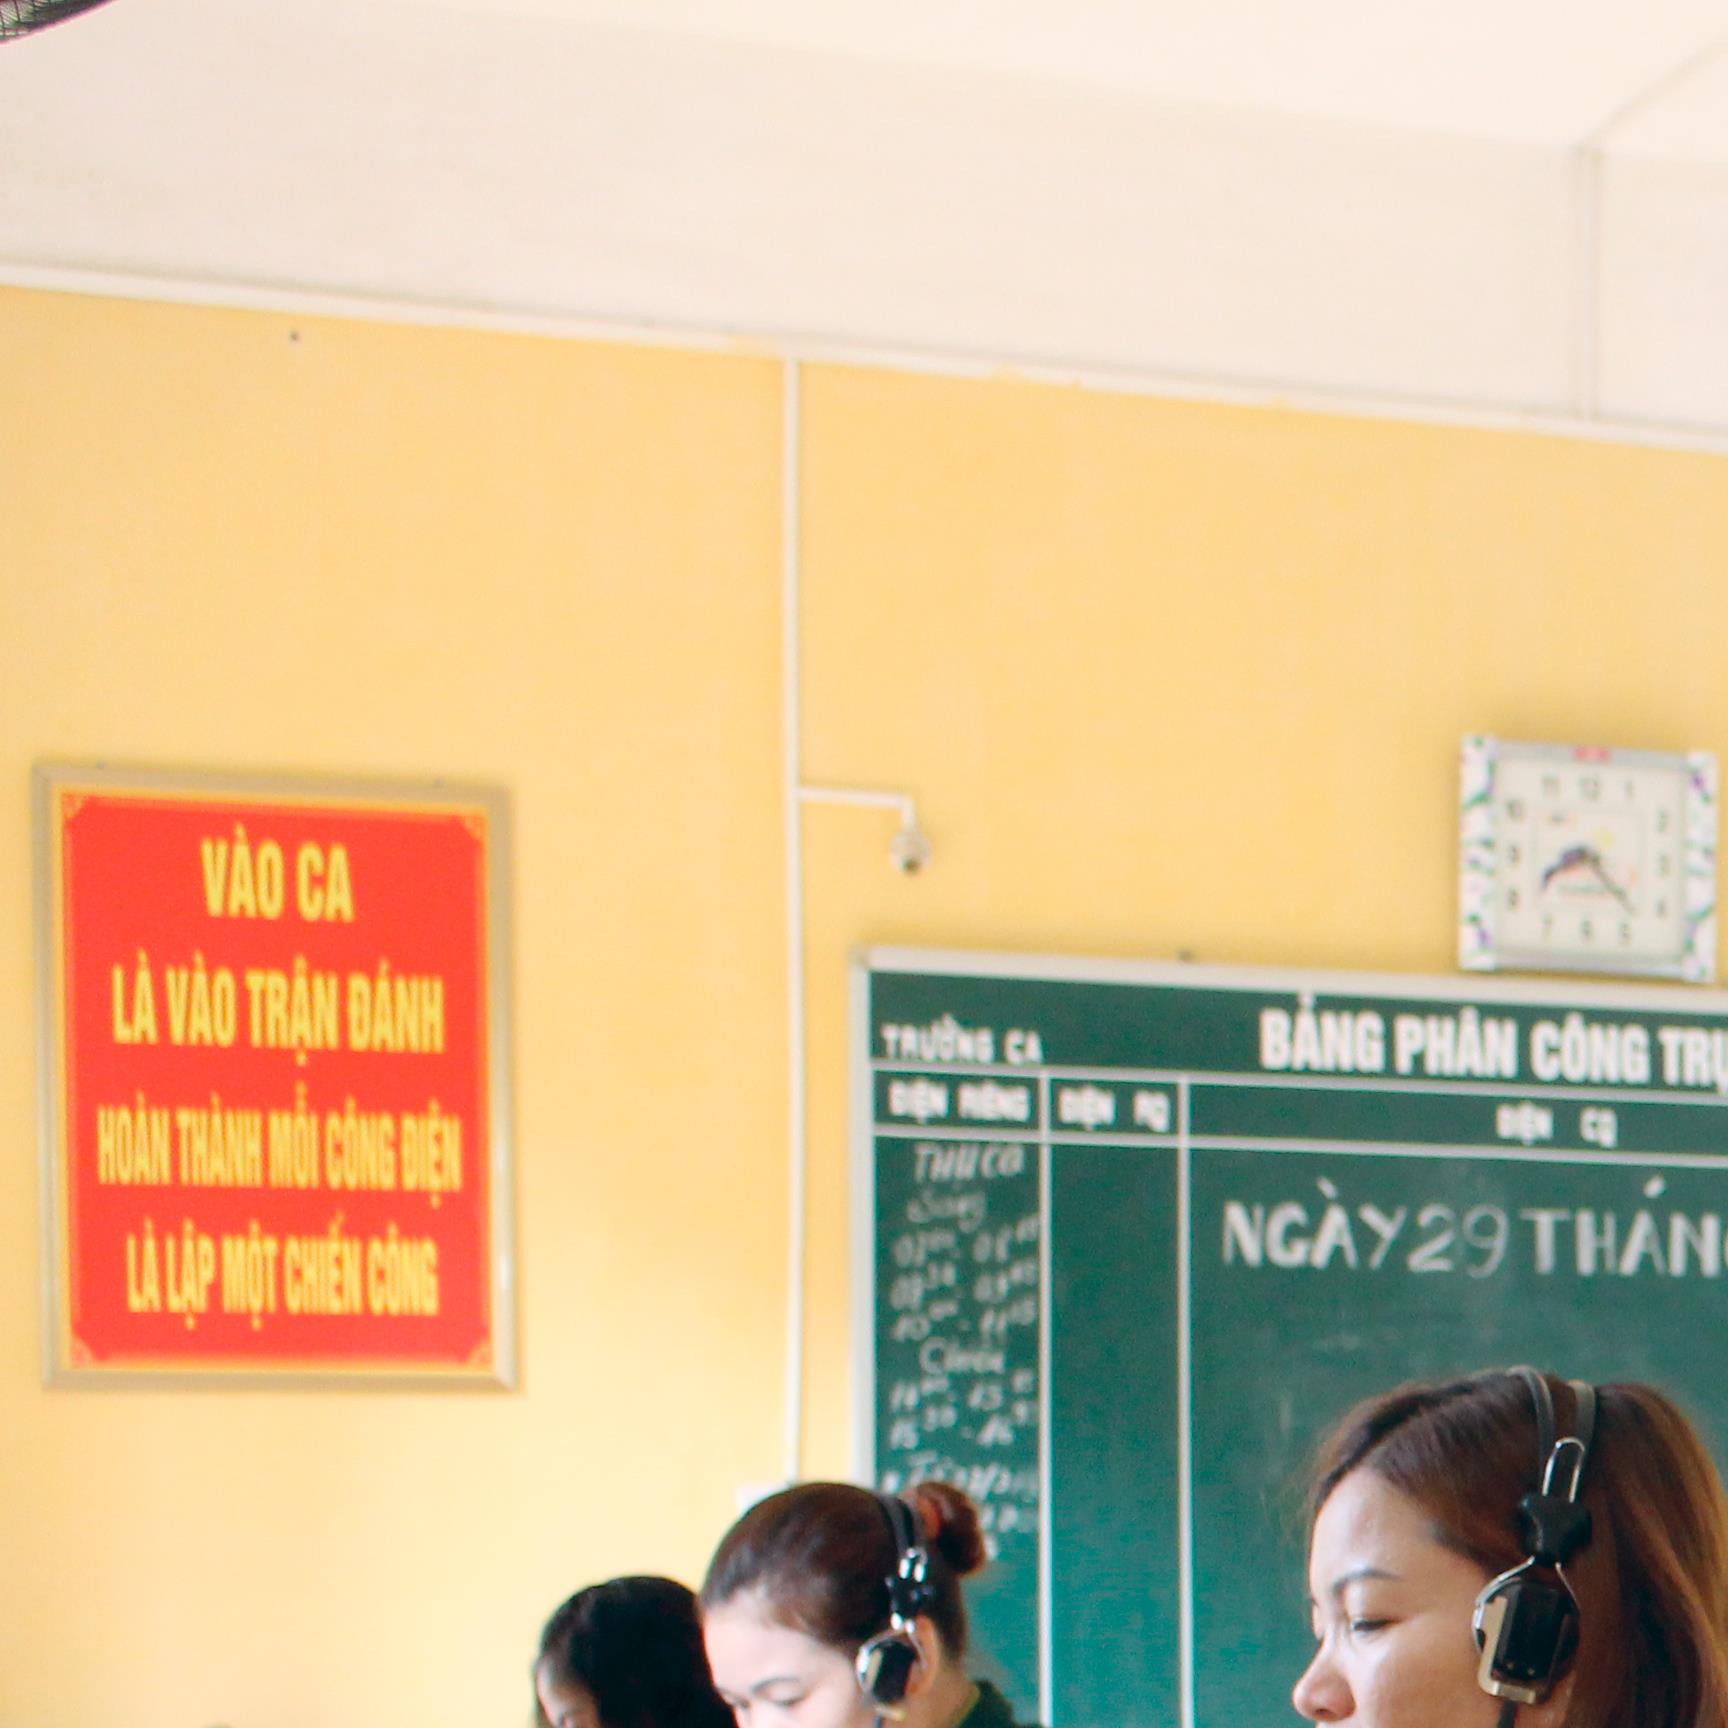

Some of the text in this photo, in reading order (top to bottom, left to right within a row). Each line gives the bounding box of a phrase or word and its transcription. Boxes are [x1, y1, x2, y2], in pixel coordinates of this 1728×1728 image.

[201, 824, 354, 922] VÀO CA
[112, 950, 445, 1066] LÀ VÀO TRẬN ĐÁNH
[1005, 1030, 1043, 1064] CA
[1259, 988, 1386, 1071] BẢNG
[1394, 1007, 1518, 1078] PHÂN
[1531, 1012, 1650, 1085] CÔNG
[97, 1093, 171, 1185] HOÀN
[175, 1094, 264, 1187] THÀNH
[325, 1096, 397, 1191] CÔNG
[127, 1219, 162, 1312] LÀ
[221, 1220, 279, 1330] MỘT
[283, 1213, 364, 1315] CHIẾN
[366, 1224, 440, 1316] CÔNG
[1222, 1177, 1402, 1270] NGÀY
[1406, 1205, 1510, 1280] 29
